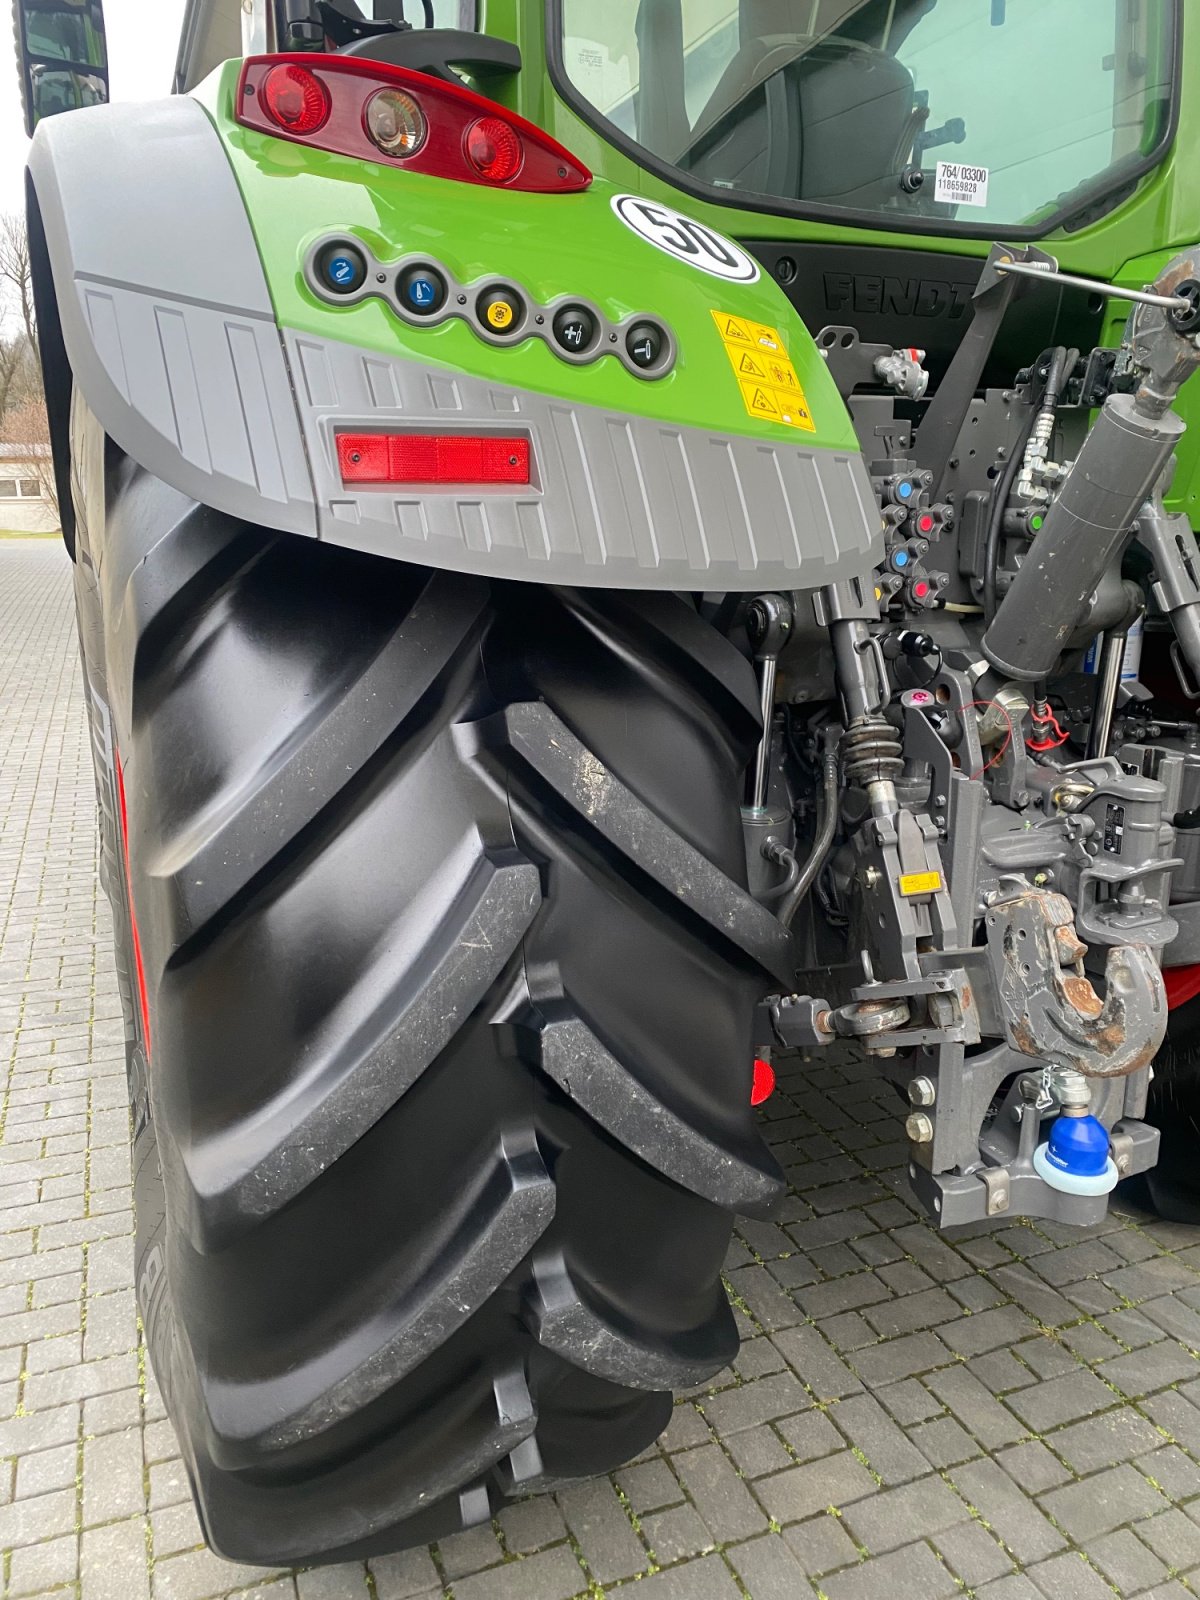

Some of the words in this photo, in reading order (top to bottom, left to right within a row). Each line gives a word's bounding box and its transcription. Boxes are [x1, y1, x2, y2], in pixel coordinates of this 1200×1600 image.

[938, 178, 977, 193] 118659828
[631, 202, 739, 268] 50
[823, 272, 978, 319] FENDT
